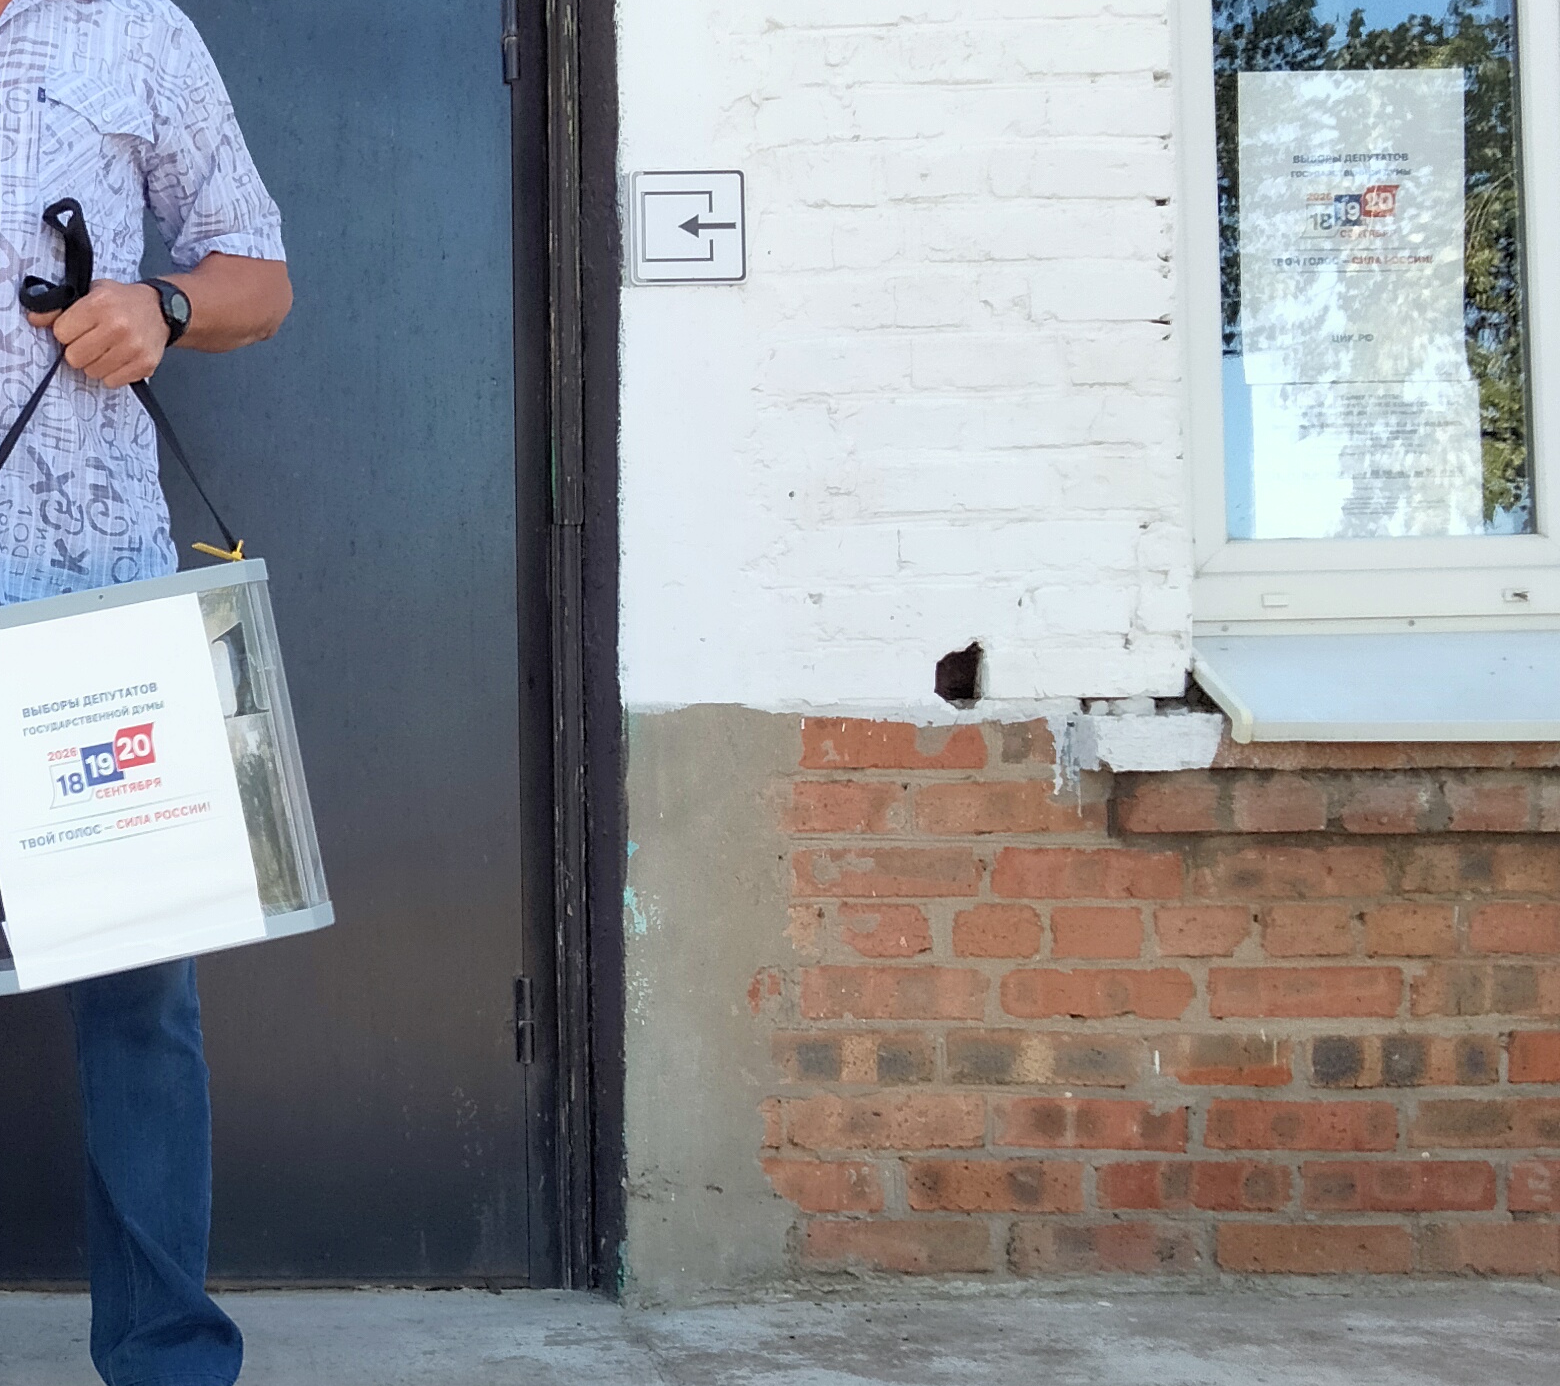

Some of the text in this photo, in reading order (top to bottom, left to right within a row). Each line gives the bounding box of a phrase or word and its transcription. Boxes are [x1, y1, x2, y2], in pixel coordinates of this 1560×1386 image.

[1309, 213, 1334, 231] 18
[22, 682, 158, 718] ВЫБОРЫ ДЕПУТАТОВ
[23, 700, 165, 736] ГОСУДАРСТВЕННОЙ ДУМЫ
[117, 734, 152, 761] 20
[47, 747, 115, 779] 2026 19
[56, 772, 84, 797] 18
[95, 777, 162, 800] СЕНТЯБРЯ
[19, 831, 55, 850] ТВОЙ
[58, 823, 102, 843] ГОЛОС
[116, 815, 151, 830] СИЛА
[154, 801, 211, 822] РОССИИ!
